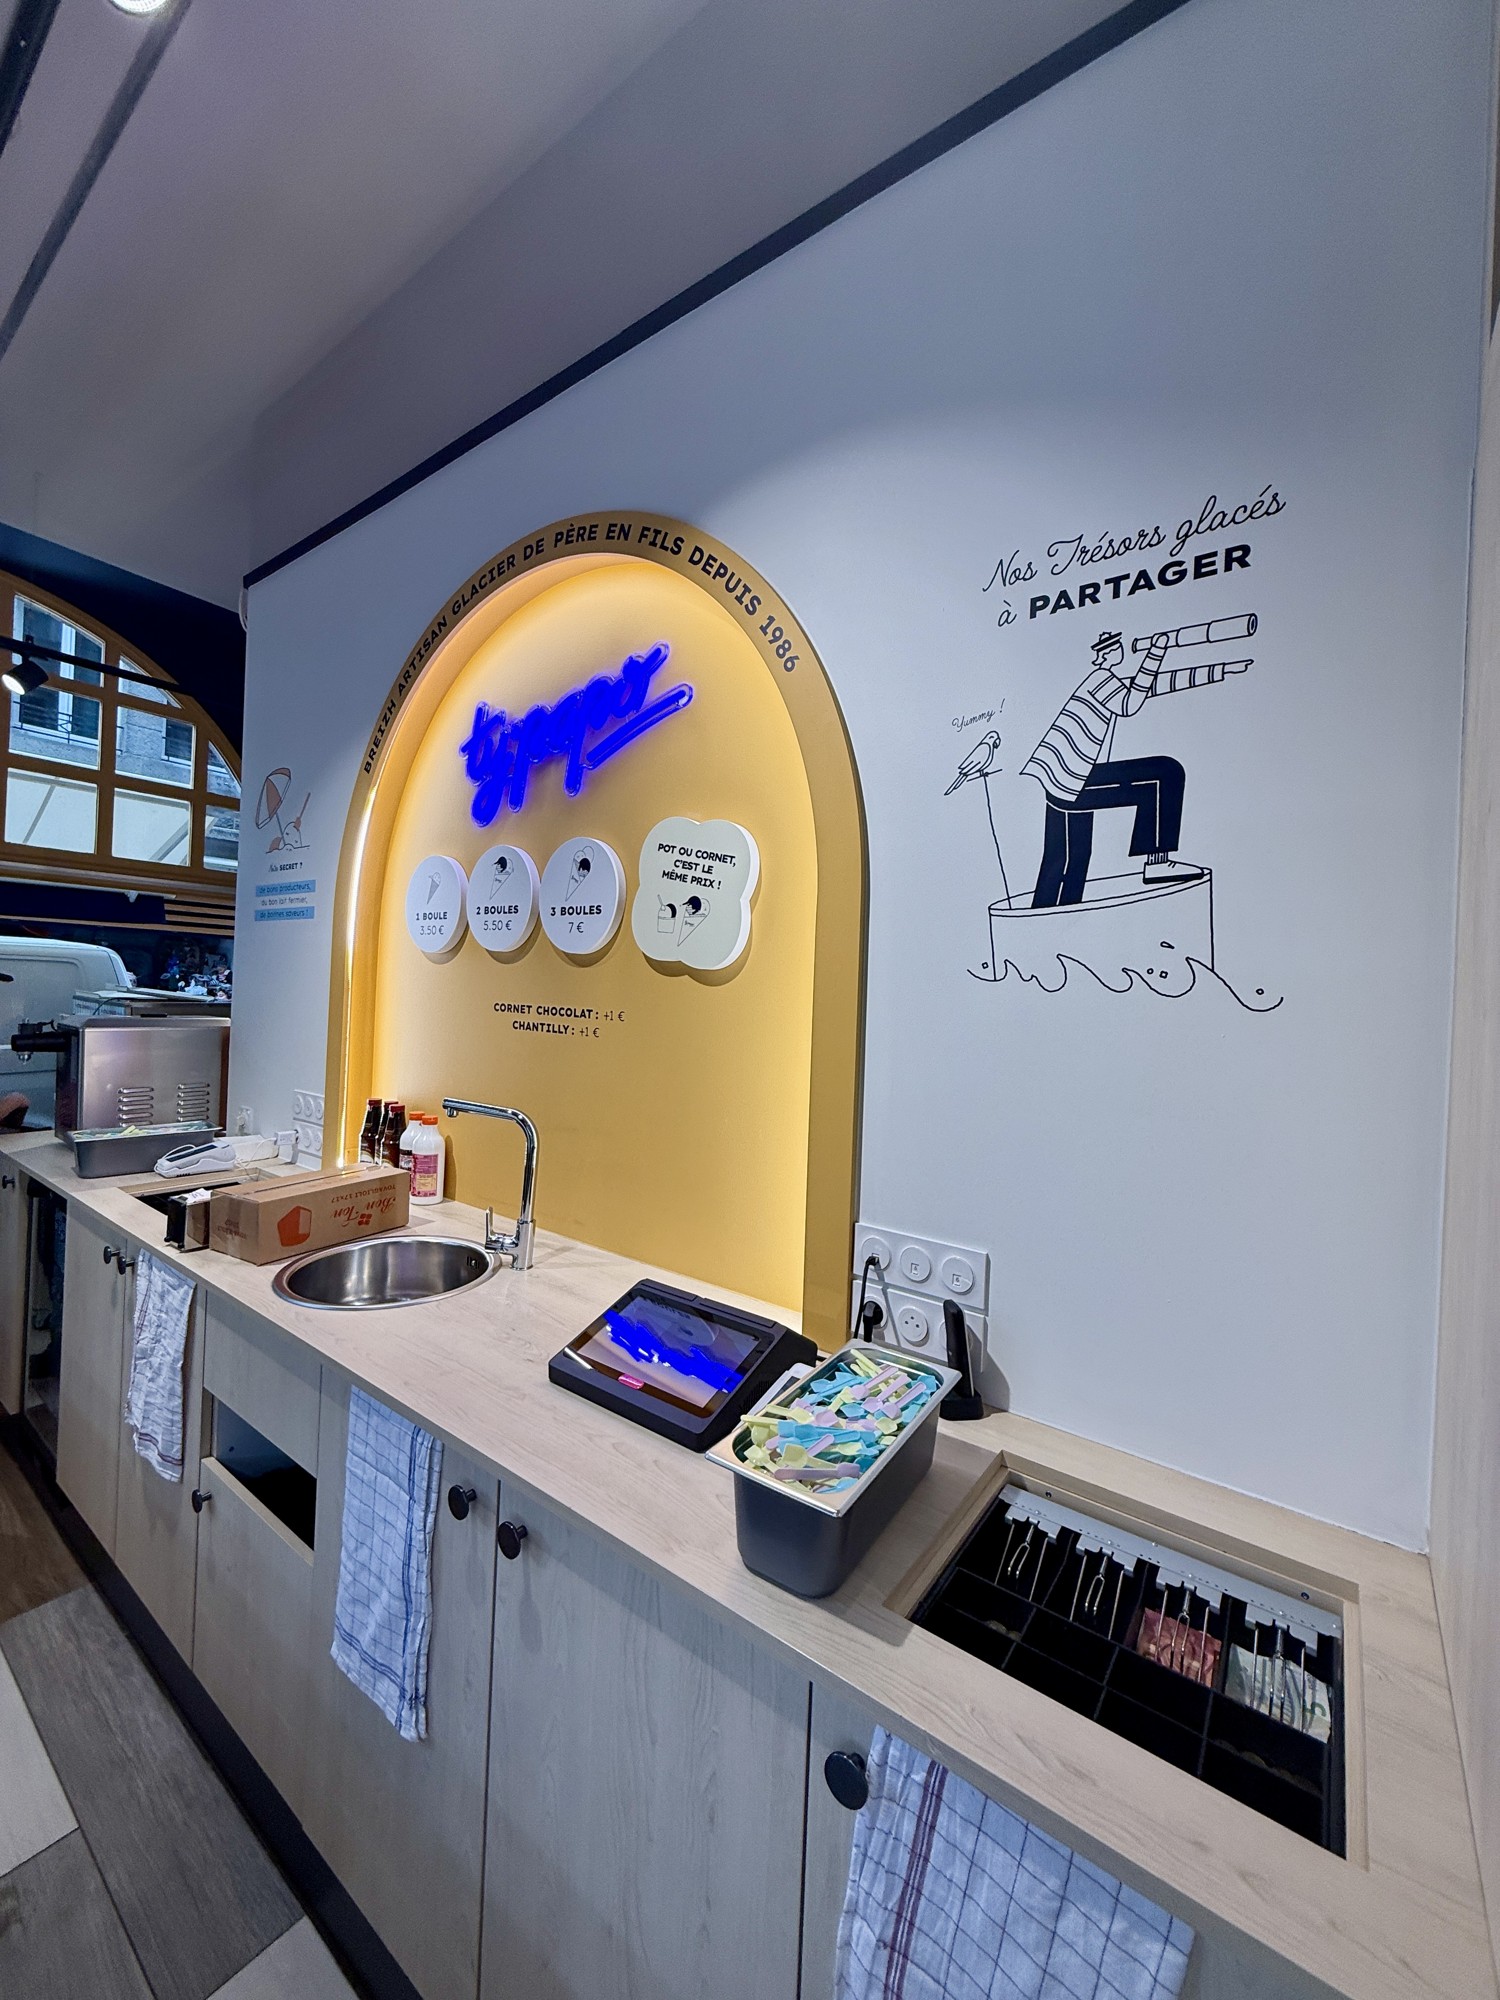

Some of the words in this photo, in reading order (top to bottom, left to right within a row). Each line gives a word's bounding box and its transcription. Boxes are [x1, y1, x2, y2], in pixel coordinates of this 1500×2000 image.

[983, 550, 1038, 592] Nos
[1047, 531, 1166, 576] Trésors
[1170, 484, 1286, 557] glacés
[998, 600, 1017, 627] à
[1029, 544, 1252, 619] PARTAGER
[364, 699, 396, 774] BREIZH
[398, 615, 448, 696] ARTISAN
[452, 553, 516, 616] GLACIER
[523, 537, 545, 562] DE
[553, 523, 599, 548] PÈRE
[605, 523, 632, 541] EN
[638, 526, 685, 555] FILS
[688, 545, 762, 616] DEPUIS
[759, 615, 800, 673] 1986
[951, 708, 996, 733] Yummy
[657, 843, 677, 854] POT
[678, 847, 693, 857] OU
[695, 849, 736, 867] CORNET,
[279, 862, 298, 871] SECRET
[701, 864, 714, 874] LE
[662, 869, 689, 883] MÊME
[690, 875, 715, 889] PRIX
[415, 912, 420, 921] 1
[422, 911, 448, 921] BOULE
[476, 906, 481, 915] 2
[484, 905, 519, 915] BOULES
[550, 907, 556, 917] 3
[560, 904, 602, 916] BOULES
[419, 925, 437, 936] 3.50
[438, 925, 445, 935] €
[483, 920, 504, 931] 5.50
[505, 920, 513, 931] €
[568, 922, 574, 933] 7
[576, 921, 584, 933] €
[493, 1002, 533, 1014] CORNET
[617, 1011, 625, 1022] €
[592, 1027, 600, 1038] €
[355, 1184, 396, 1199] TOVAGLIOLI
[366, 1196, 396, 1214] Bon
